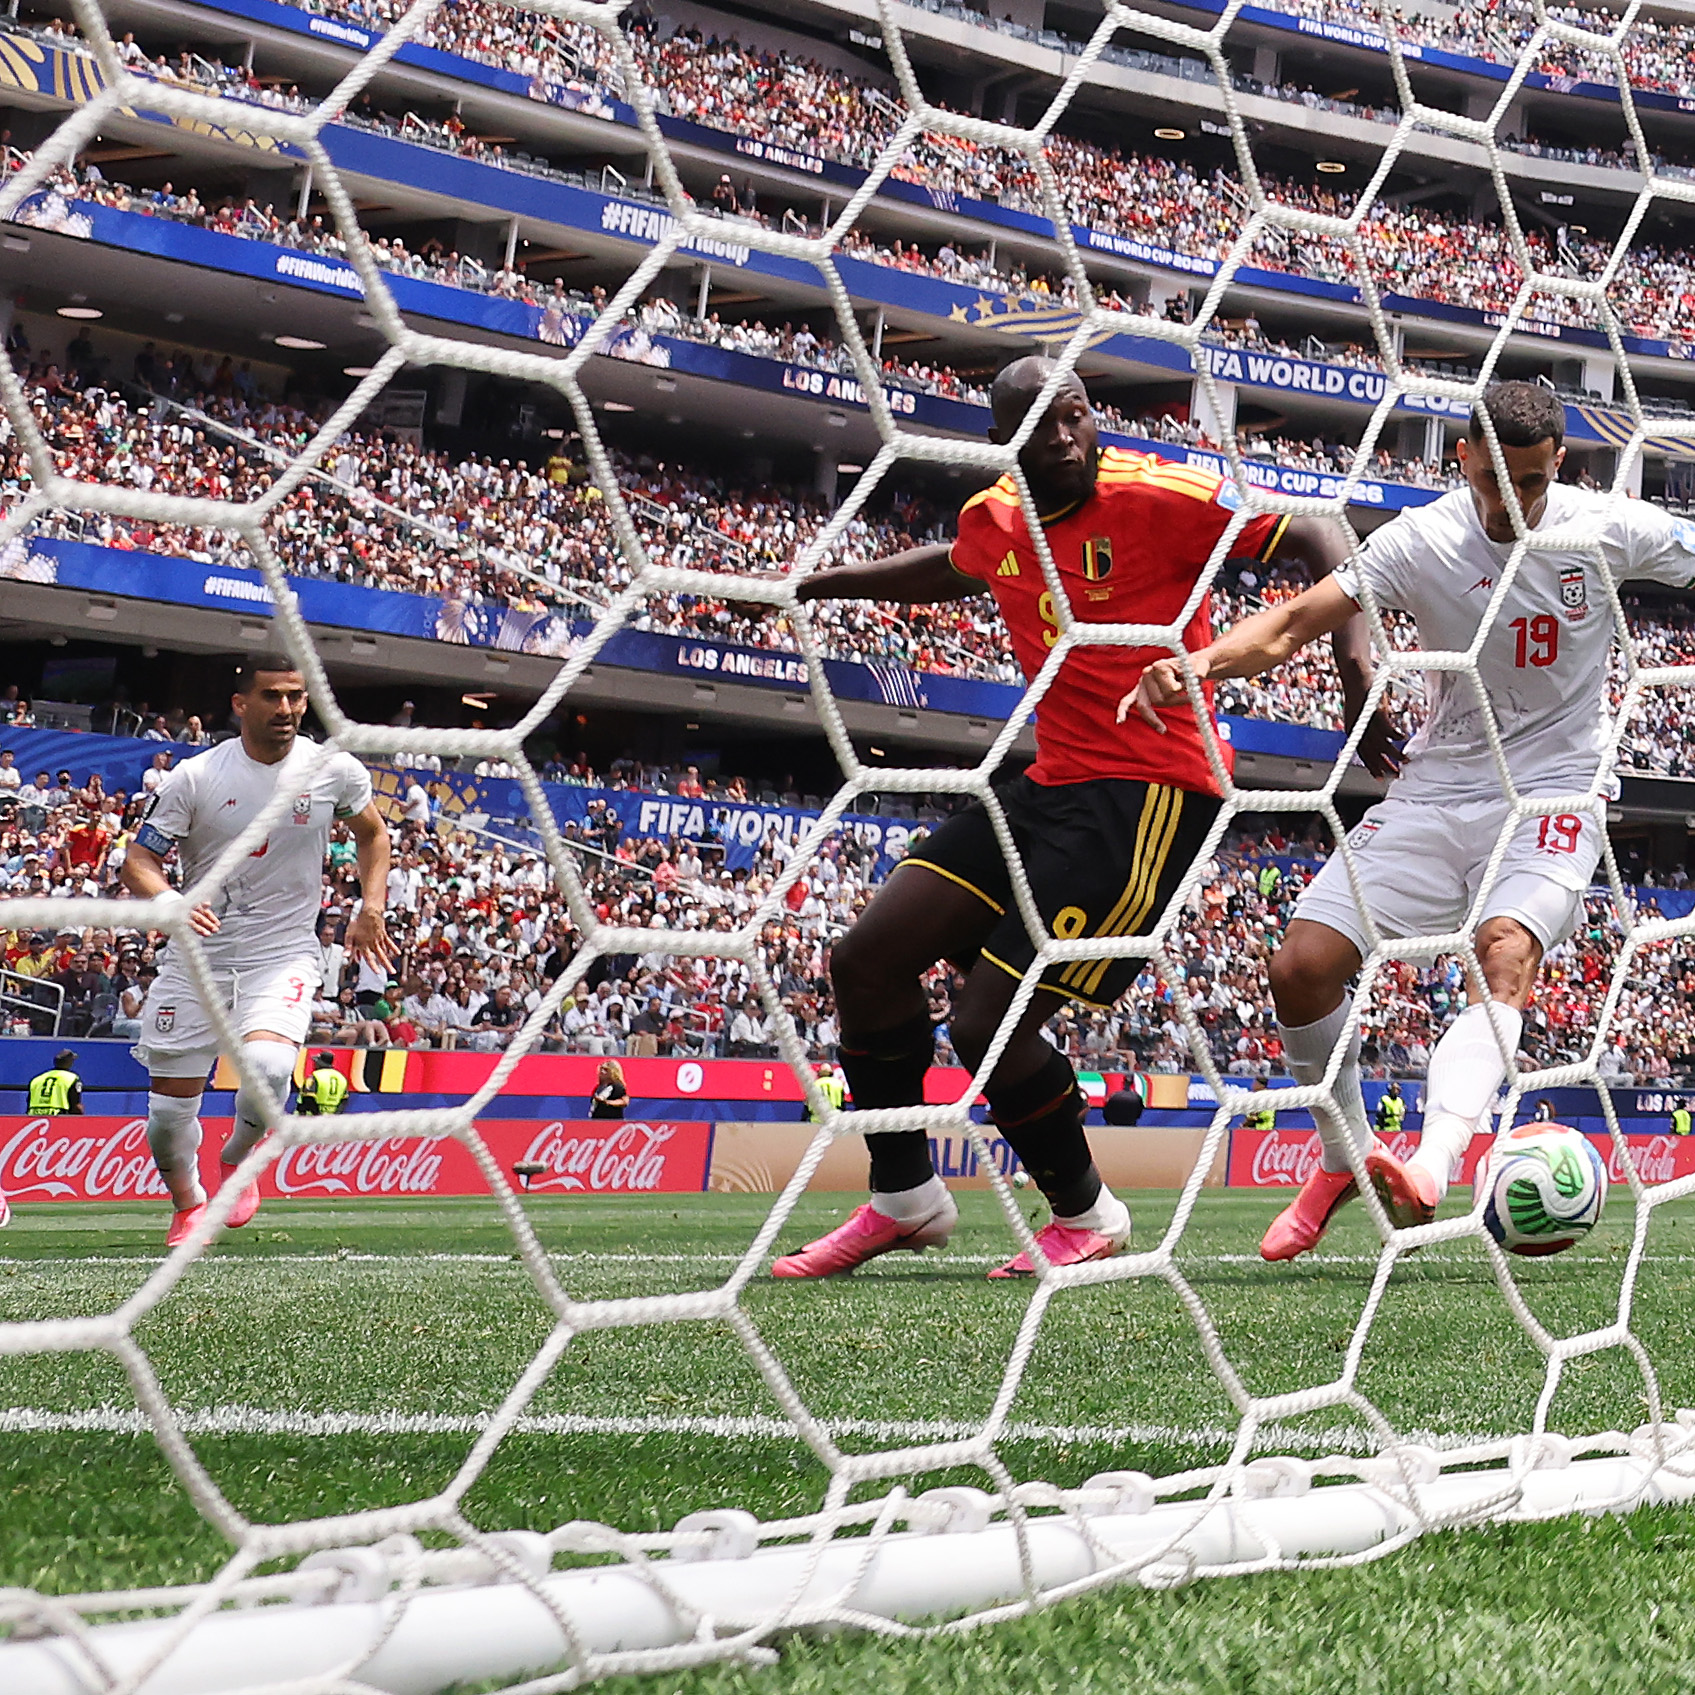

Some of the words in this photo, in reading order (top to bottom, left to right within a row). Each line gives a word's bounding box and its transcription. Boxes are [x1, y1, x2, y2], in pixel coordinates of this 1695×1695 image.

[1298, 18, 1323, 35] FIFA
[1323, 24, 1362, 43] WORLD
[1363, 33, 1384, 49] CUP
[736, 138, 763, 158] LOS
[764, 146, 823, 174] ANGELES
[1090, 230, 1114, 246] FIFA
[1114, 236, 1152, 258] WORLD
[1152, 247, 1172, 263] CUP
[1172, 251, 1215, 274] 2026
[1511, 317, 1561, 338] NGELES
[783, 367, 825, 394] LOS
[826, 377, 916, 414] ANGLES
[1247, 356, 1346, 393] WORLD
[1186, 451, 1222, 476] FIFA
[1281, 471, 1318, 495] CUP
[1038, 590, 1062, 648] 9
[1508, 614, 1559, 669] 19
[678, 645, 718, 671] LOS
[720, 651, 809, 684] ANGELES
[639, 799, 706, 837] FIFA
[1535, 813, 1583, 854] 19
[1636, 1093, 1663, 1113] LOS
[519, 1121, 677, 1190] Coca-Cola
